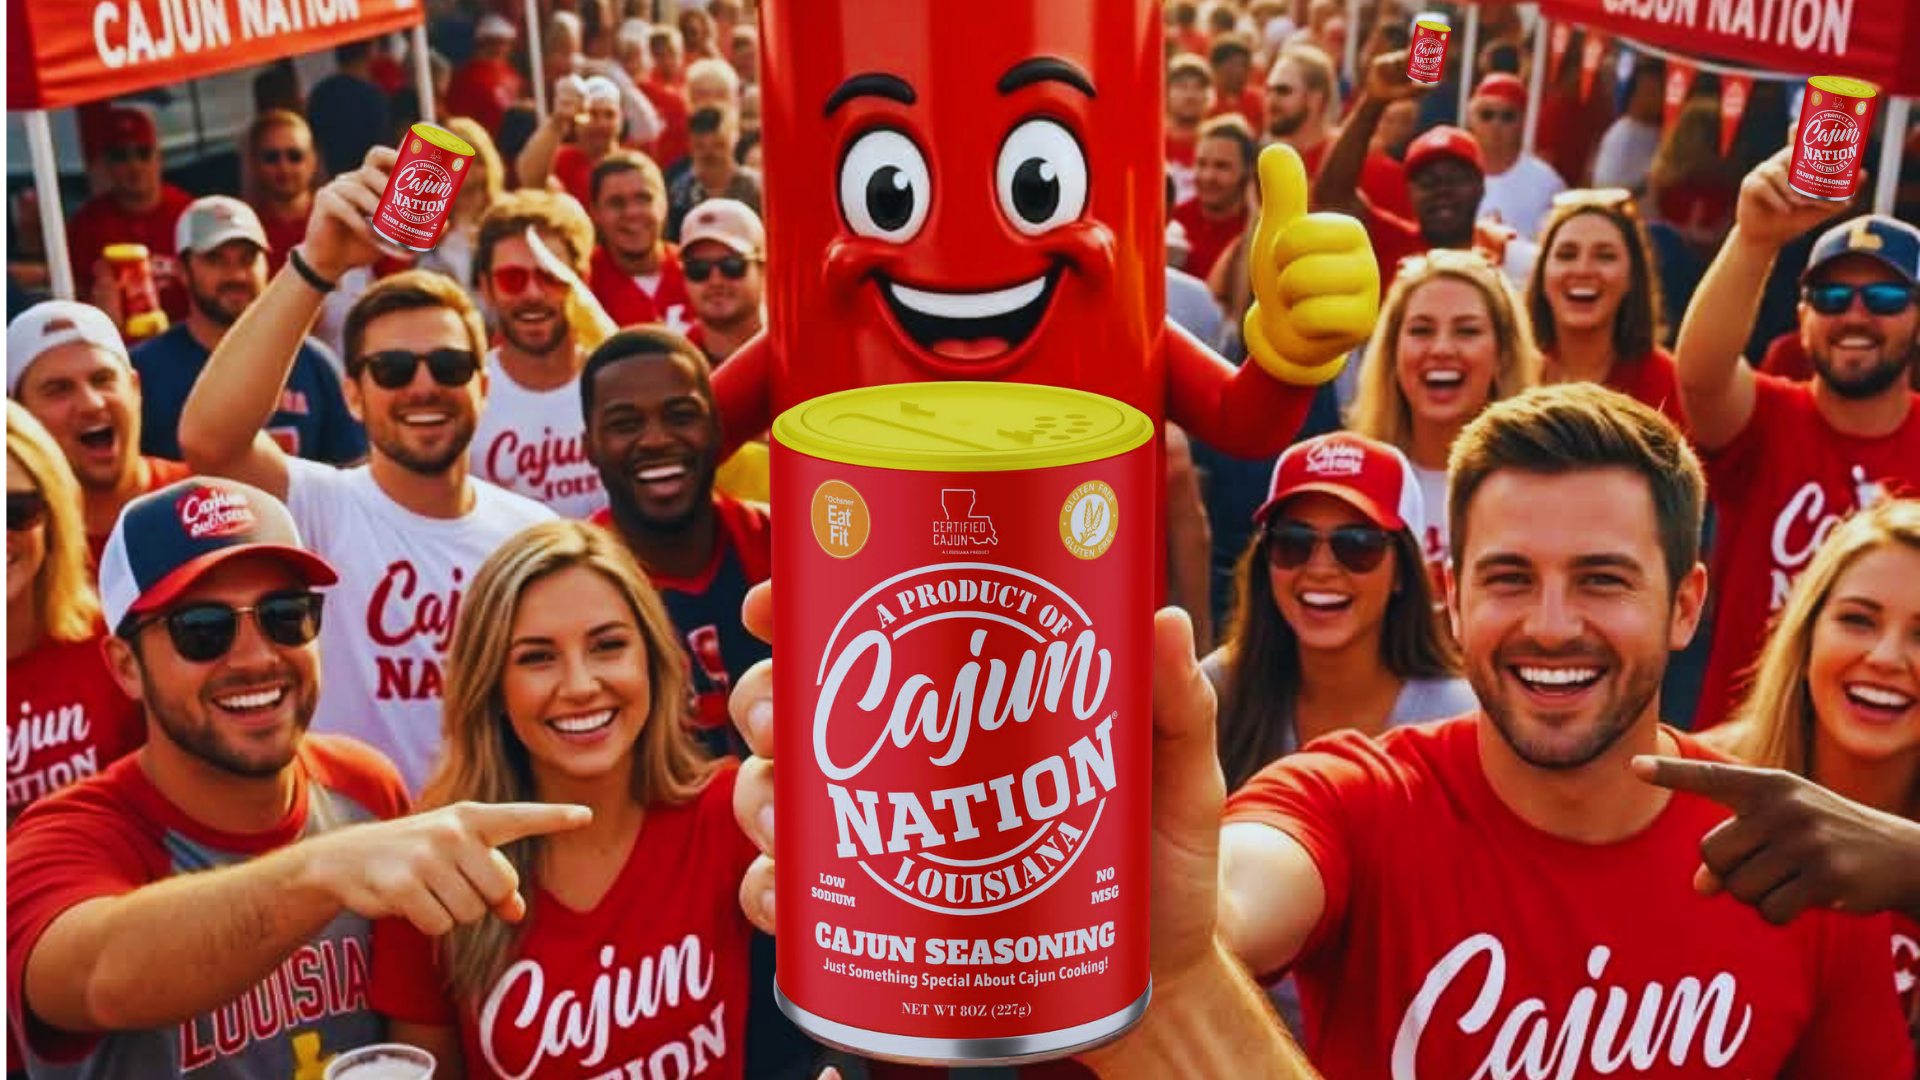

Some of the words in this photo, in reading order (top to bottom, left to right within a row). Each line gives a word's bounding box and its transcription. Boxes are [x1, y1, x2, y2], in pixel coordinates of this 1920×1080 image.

[94, 0, 231, 67] CAJUN
[1706, 0, 1852, 56] NATION
[1803, 119, 1860, 147] Cajun
[1803, 144, 1857, 160] NATION
[1813, 160, 1849, 173] LOUISIANA
[395, 167, 452, 198] Cajun
[1815, 176, 1850, 186] SEASONING
[392, 190, 447, 212] NATION
[399, 207, 435, 222] LOUISIANA
[399, 220, 434, 238] SEASONING
[1064, 482, 1095, 513] GLUTEN
[1097, 484, 1115, 504] FREE
[828, 504, 851, 527] Eat
[933, 521, 986, 533] CERTIFIED
[830, 524, 849, 547] Fit
[933, 534, 968, 546] CAJUN
[1065, 536, 1095, 557] GLUTEN
[1097, 529, 1115, 553] FREE
[876, 603, 897, 629] A
[896, 579, 1037, 615] PRODUCT
[1038, 604, 1073, 637] OF
[813, 628, 1112, 781] Cajun
[893, 821, 1083, 904] LOUISIANA
[820, 872, 846, 889] LOW
[1096, 866, 1115, 884] NO
[811, 886, 856, 908] SODIUM
[1091, 884, 1119, 905] MSG
[814, 921, 916, 963] CAJUN
[925, 921, 1115, 966] SEASONING
[823, 957, 847, 976] Just
[848, 963, 918, 989] Something
[921, 972, 970, 990] Special
[973, 973, 1016, 987] About
[1018, 968, 1056, 988] Cajun
[1058, 956, 1109, 980] Cooking!
[480, 934, 714, 1080] Cajun
[901, 1002, 929, 1016] NET
[934, 1004, 957, 1017] WT
[991, 1001, 1032, 1019] (227g)
[1391, 932, 1752, 1080] Cajun
[588, 1001, 724, 1080] ON
